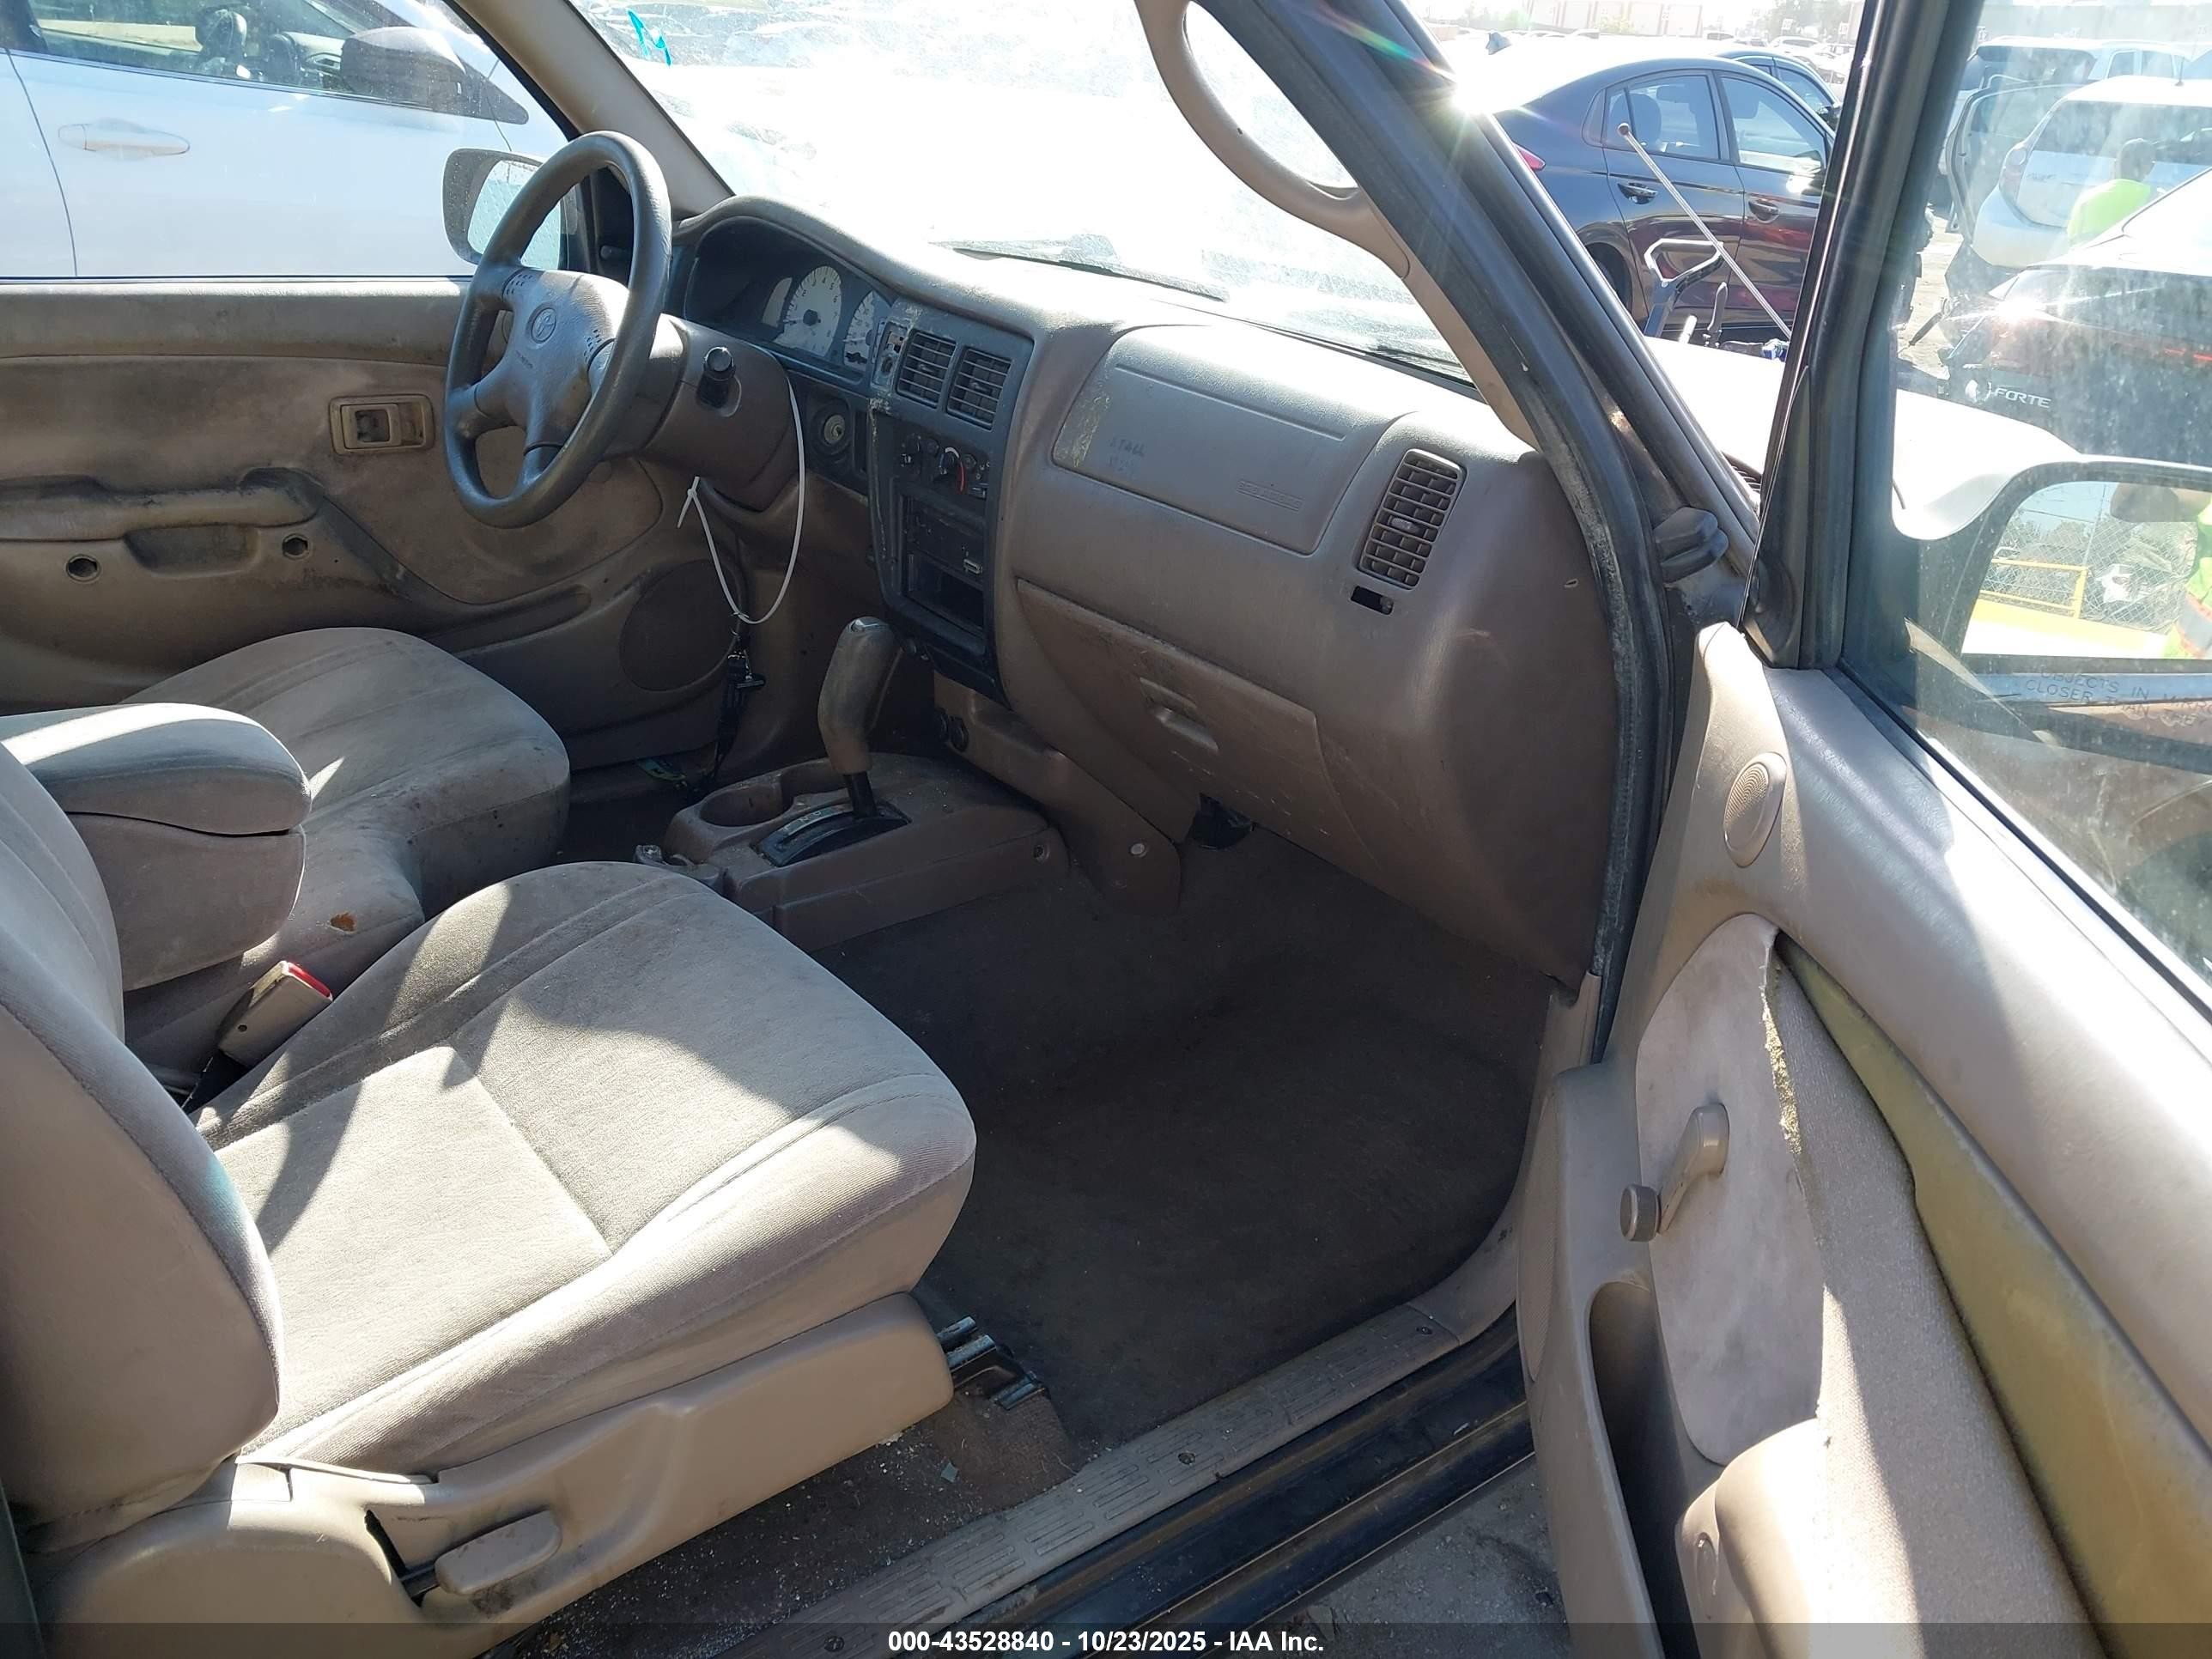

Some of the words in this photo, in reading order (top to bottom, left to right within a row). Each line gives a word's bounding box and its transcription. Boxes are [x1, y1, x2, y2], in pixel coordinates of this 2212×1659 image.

[1993, 386, 2052, 409] FORTE
[2026, 678, 2094, 704] CLOSER
[2130, 686, 2150, 701] IN
